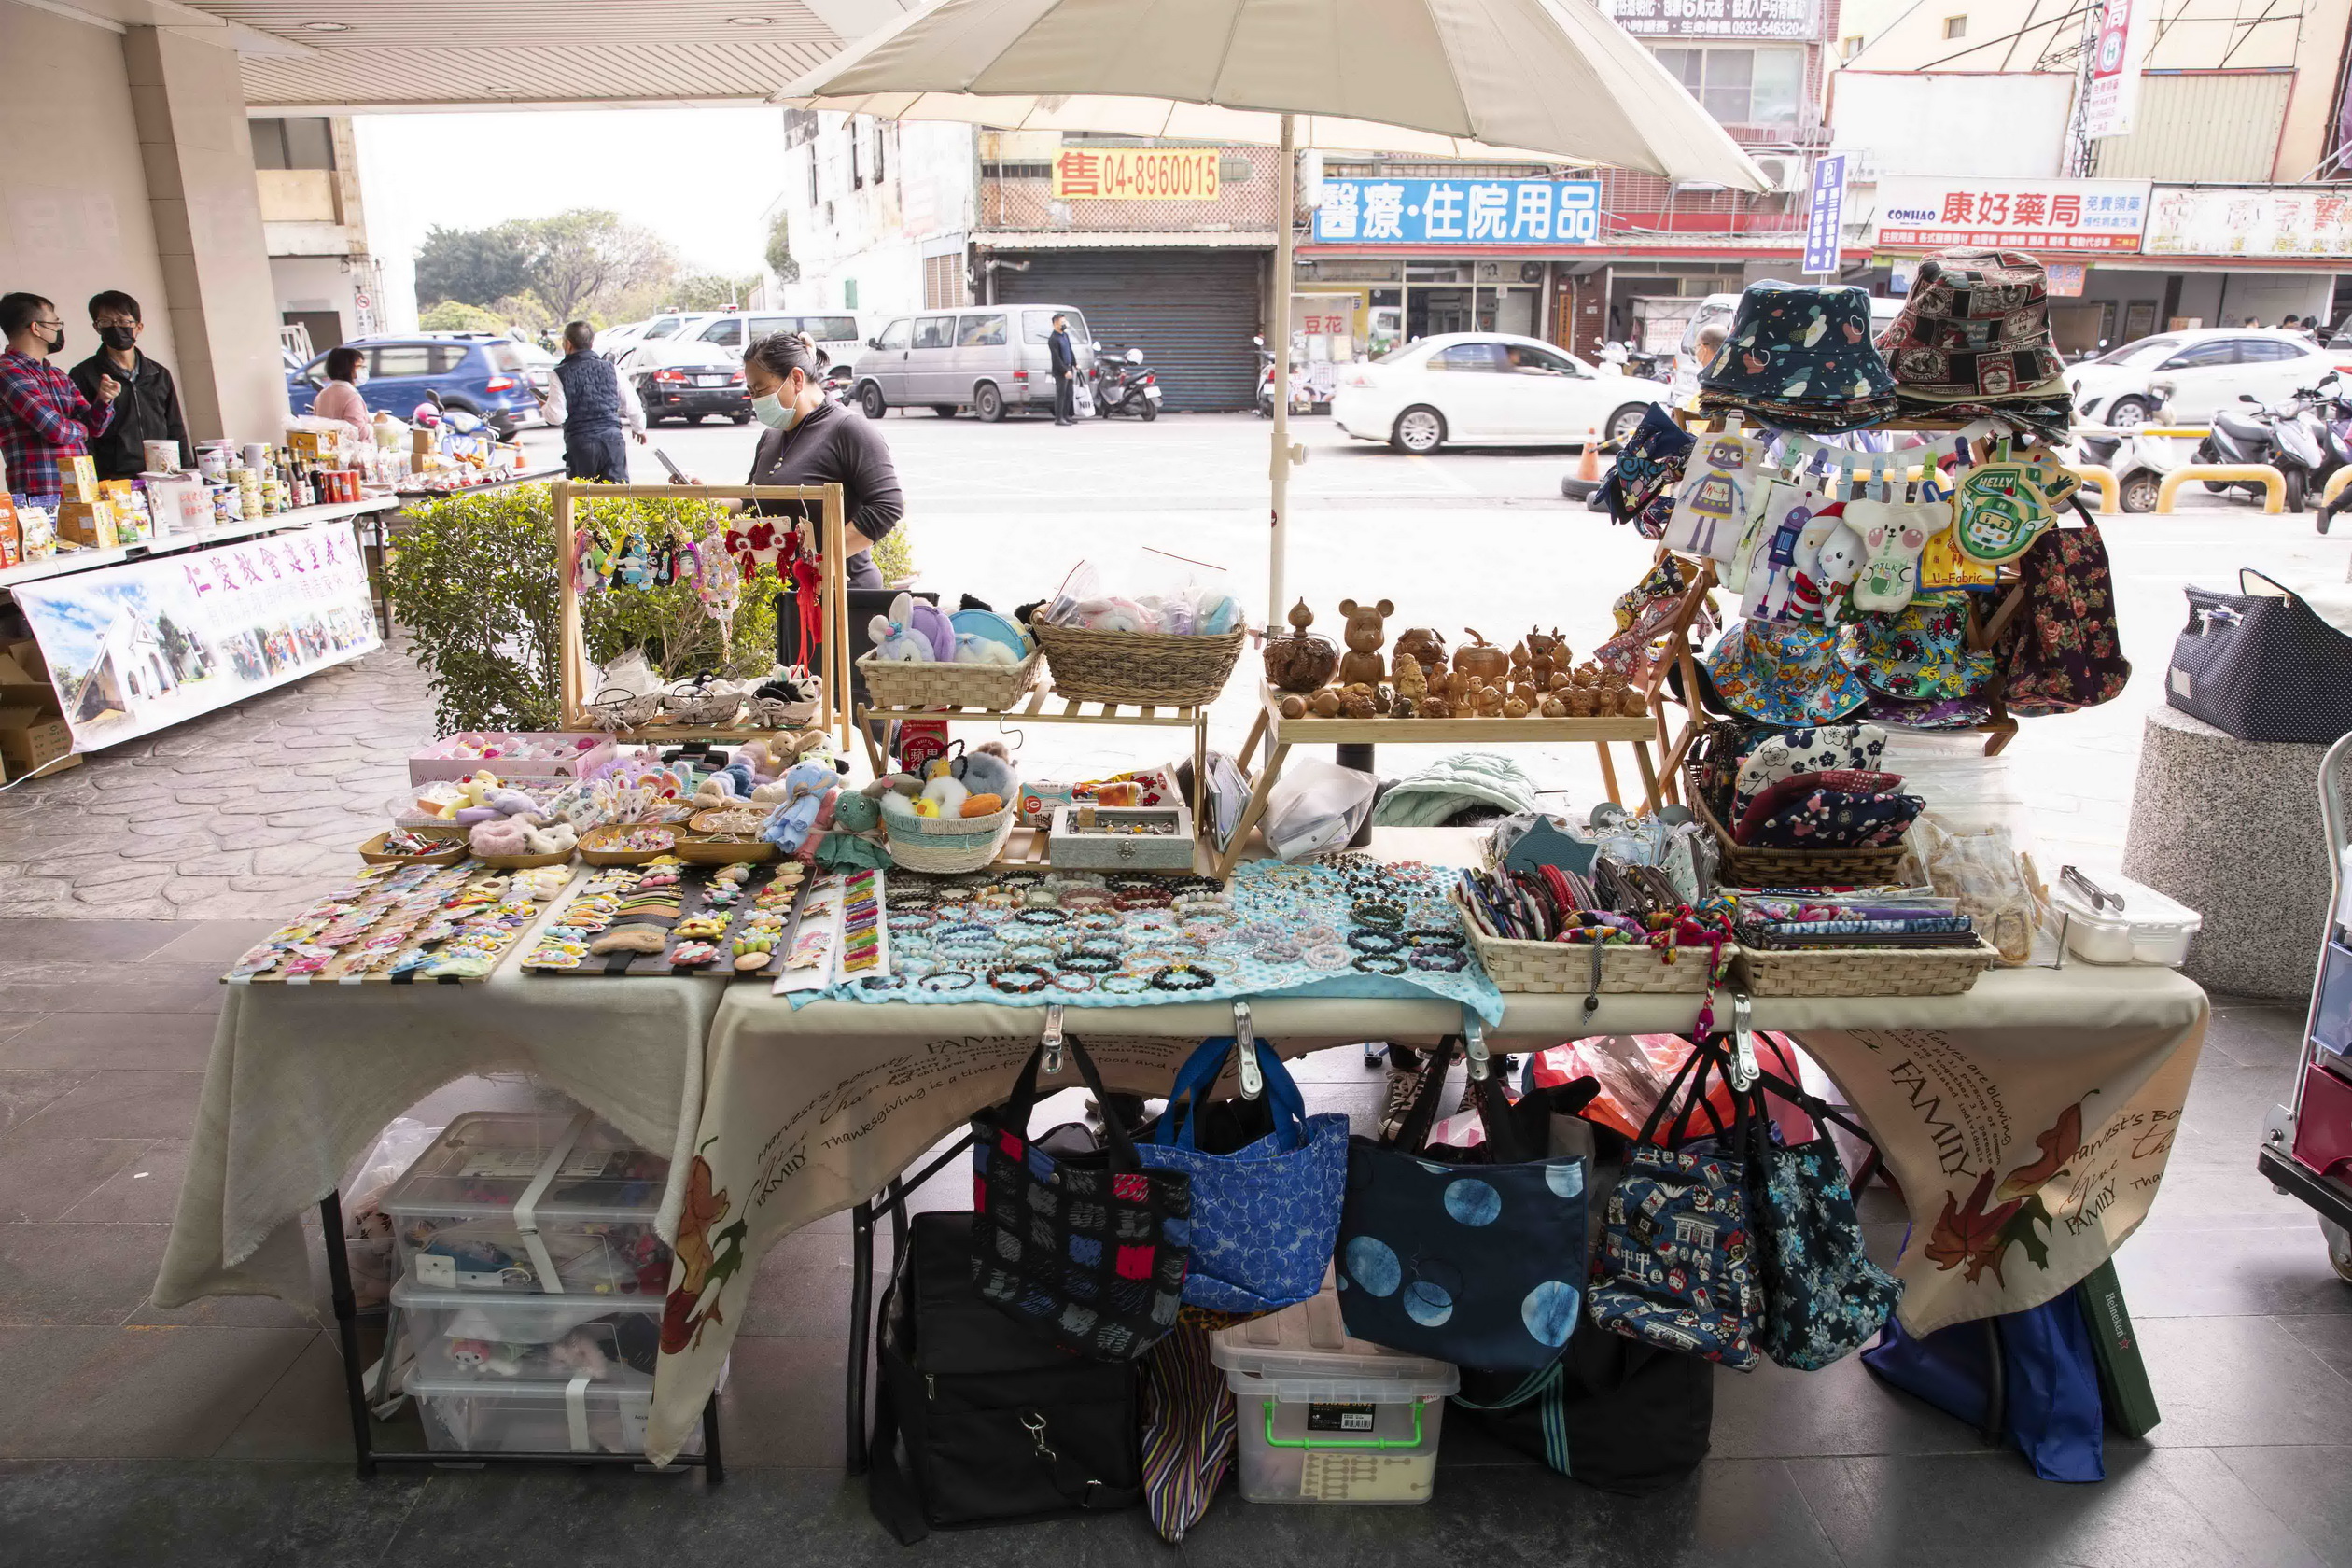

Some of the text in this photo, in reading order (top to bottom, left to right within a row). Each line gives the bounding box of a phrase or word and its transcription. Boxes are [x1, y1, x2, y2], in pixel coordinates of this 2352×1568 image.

[1057, 151, 1216, 195] 售 04-8960015
[1940, 191, 2081, 227] 康好藥局
[2084, 196, 2141, 211] 免費領藥
[1303, 315, 1343, 335] 豆花
[1979, 475, 2014, 488] HELLY
[1932, 571, 1982, 583] U-Fabric
[1097, 1056, 1166, 1070] food and
[757, 1054, 913, 1164] Harvest's Bounty
[821, 1087, 926, 1149] Thanksgiving
[930, 1079, 944, 1090] is
[961, 1064, 997, 1077] time
[1002, 1058, 1024, 1070] for
[1884, 1029, 1983, 1164] group of related individuals
[1887, 1058, 1977, 1179] FAMILY
[1936, 1059, 1970, 1099] together
[1978, 1126, 1993, 1165] parents
[1960, 1073, 1988, 1112] persons
[1987, 1115, 1996, 1127] of
[1993, 1132, 2001, 1166] common
[1967, 1064, 1988, 1084] are
[1986, 1085, 2012, 1146] blowing
[756, 1144, 806, 1208] FAMILY
[2064, 1177, 2116, 1236] FAMILY
[2105, 1292, 2124, 1337] Heineken
